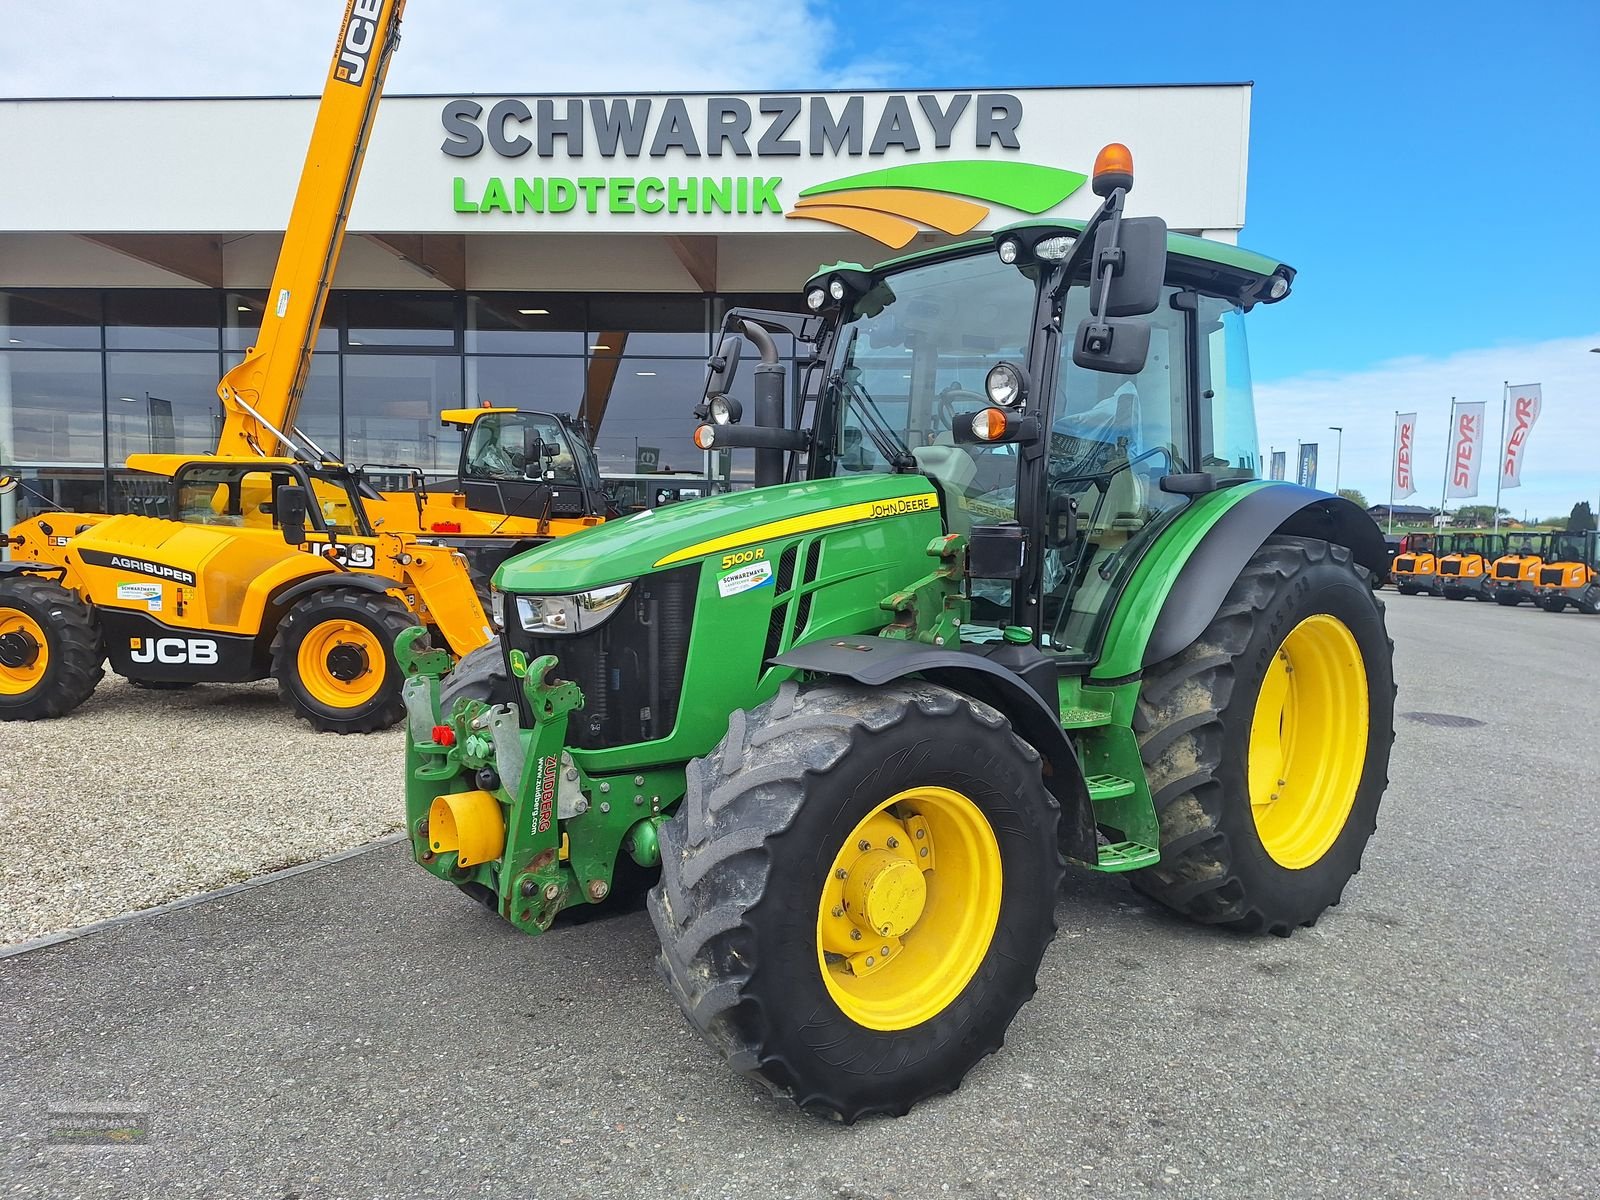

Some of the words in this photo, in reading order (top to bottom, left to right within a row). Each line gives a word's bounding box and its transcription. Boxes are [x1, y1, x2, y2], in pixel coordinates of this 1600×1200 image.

[440, 94, 1023, 158] SCHWARZMAYR
[453, 176, 783, 214] LANDTECHNIK
[1397, 423, 1411, 490] STEYR
[1453, 414, 1475, 489] STEYR
[1505, 397, 1532, 477] STEYR
[870, 503, 897, 517] JOHN
[897, 498, 930, 512] DEERE
[111, 556, 193, 584] AGRISUPER
[722, 550, 754, 569] 5100
[755, 548, 764, 559] R
[723, 568, 764, 583] SCHWARZMAYR
[130, 638, 219, 664] JCB
[531, 756, 544, 836] www.zuidberg.com
[538, 753, 557, 832] ZUIDBERG
